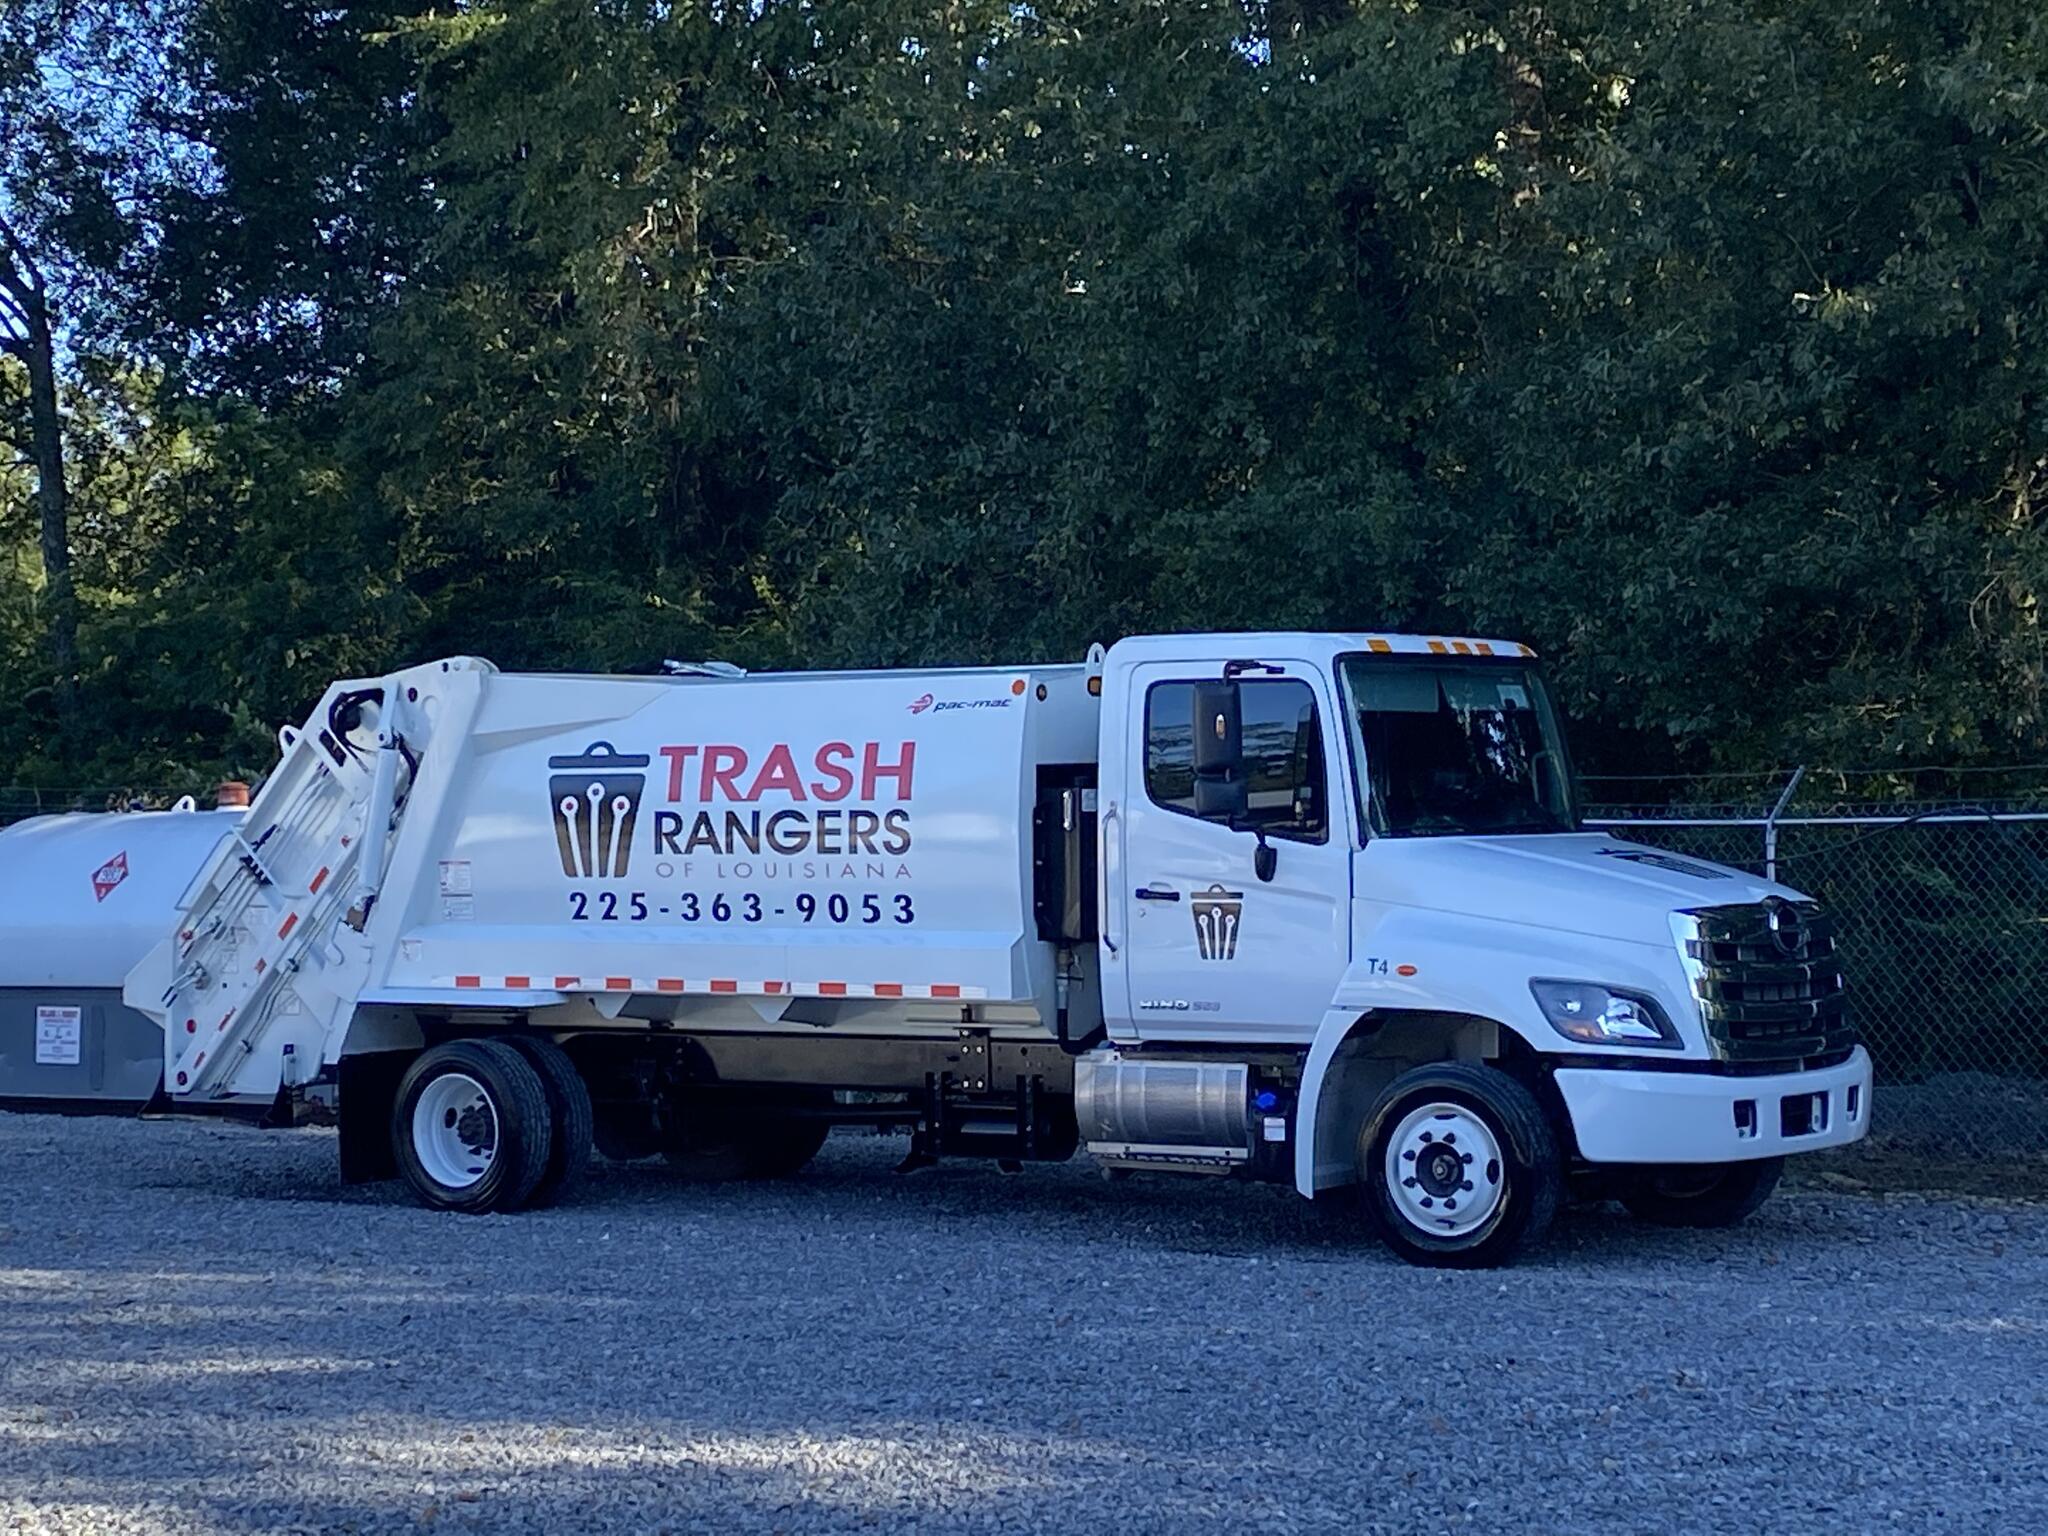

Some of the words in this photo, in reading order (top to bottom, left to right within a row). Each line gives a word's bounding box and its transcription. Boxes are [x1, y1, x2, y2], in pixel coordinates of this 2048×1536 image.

[659, 741, 916, 803] TRASH
[654, 808, 912, 856] RANGERS
[655, 862, 694, 880] OF
[717, 861, 913, 880] LOUISIANA
[569, 891, 915, 924] 225-363-9053
[1367, 957, 1389, 975] T4
